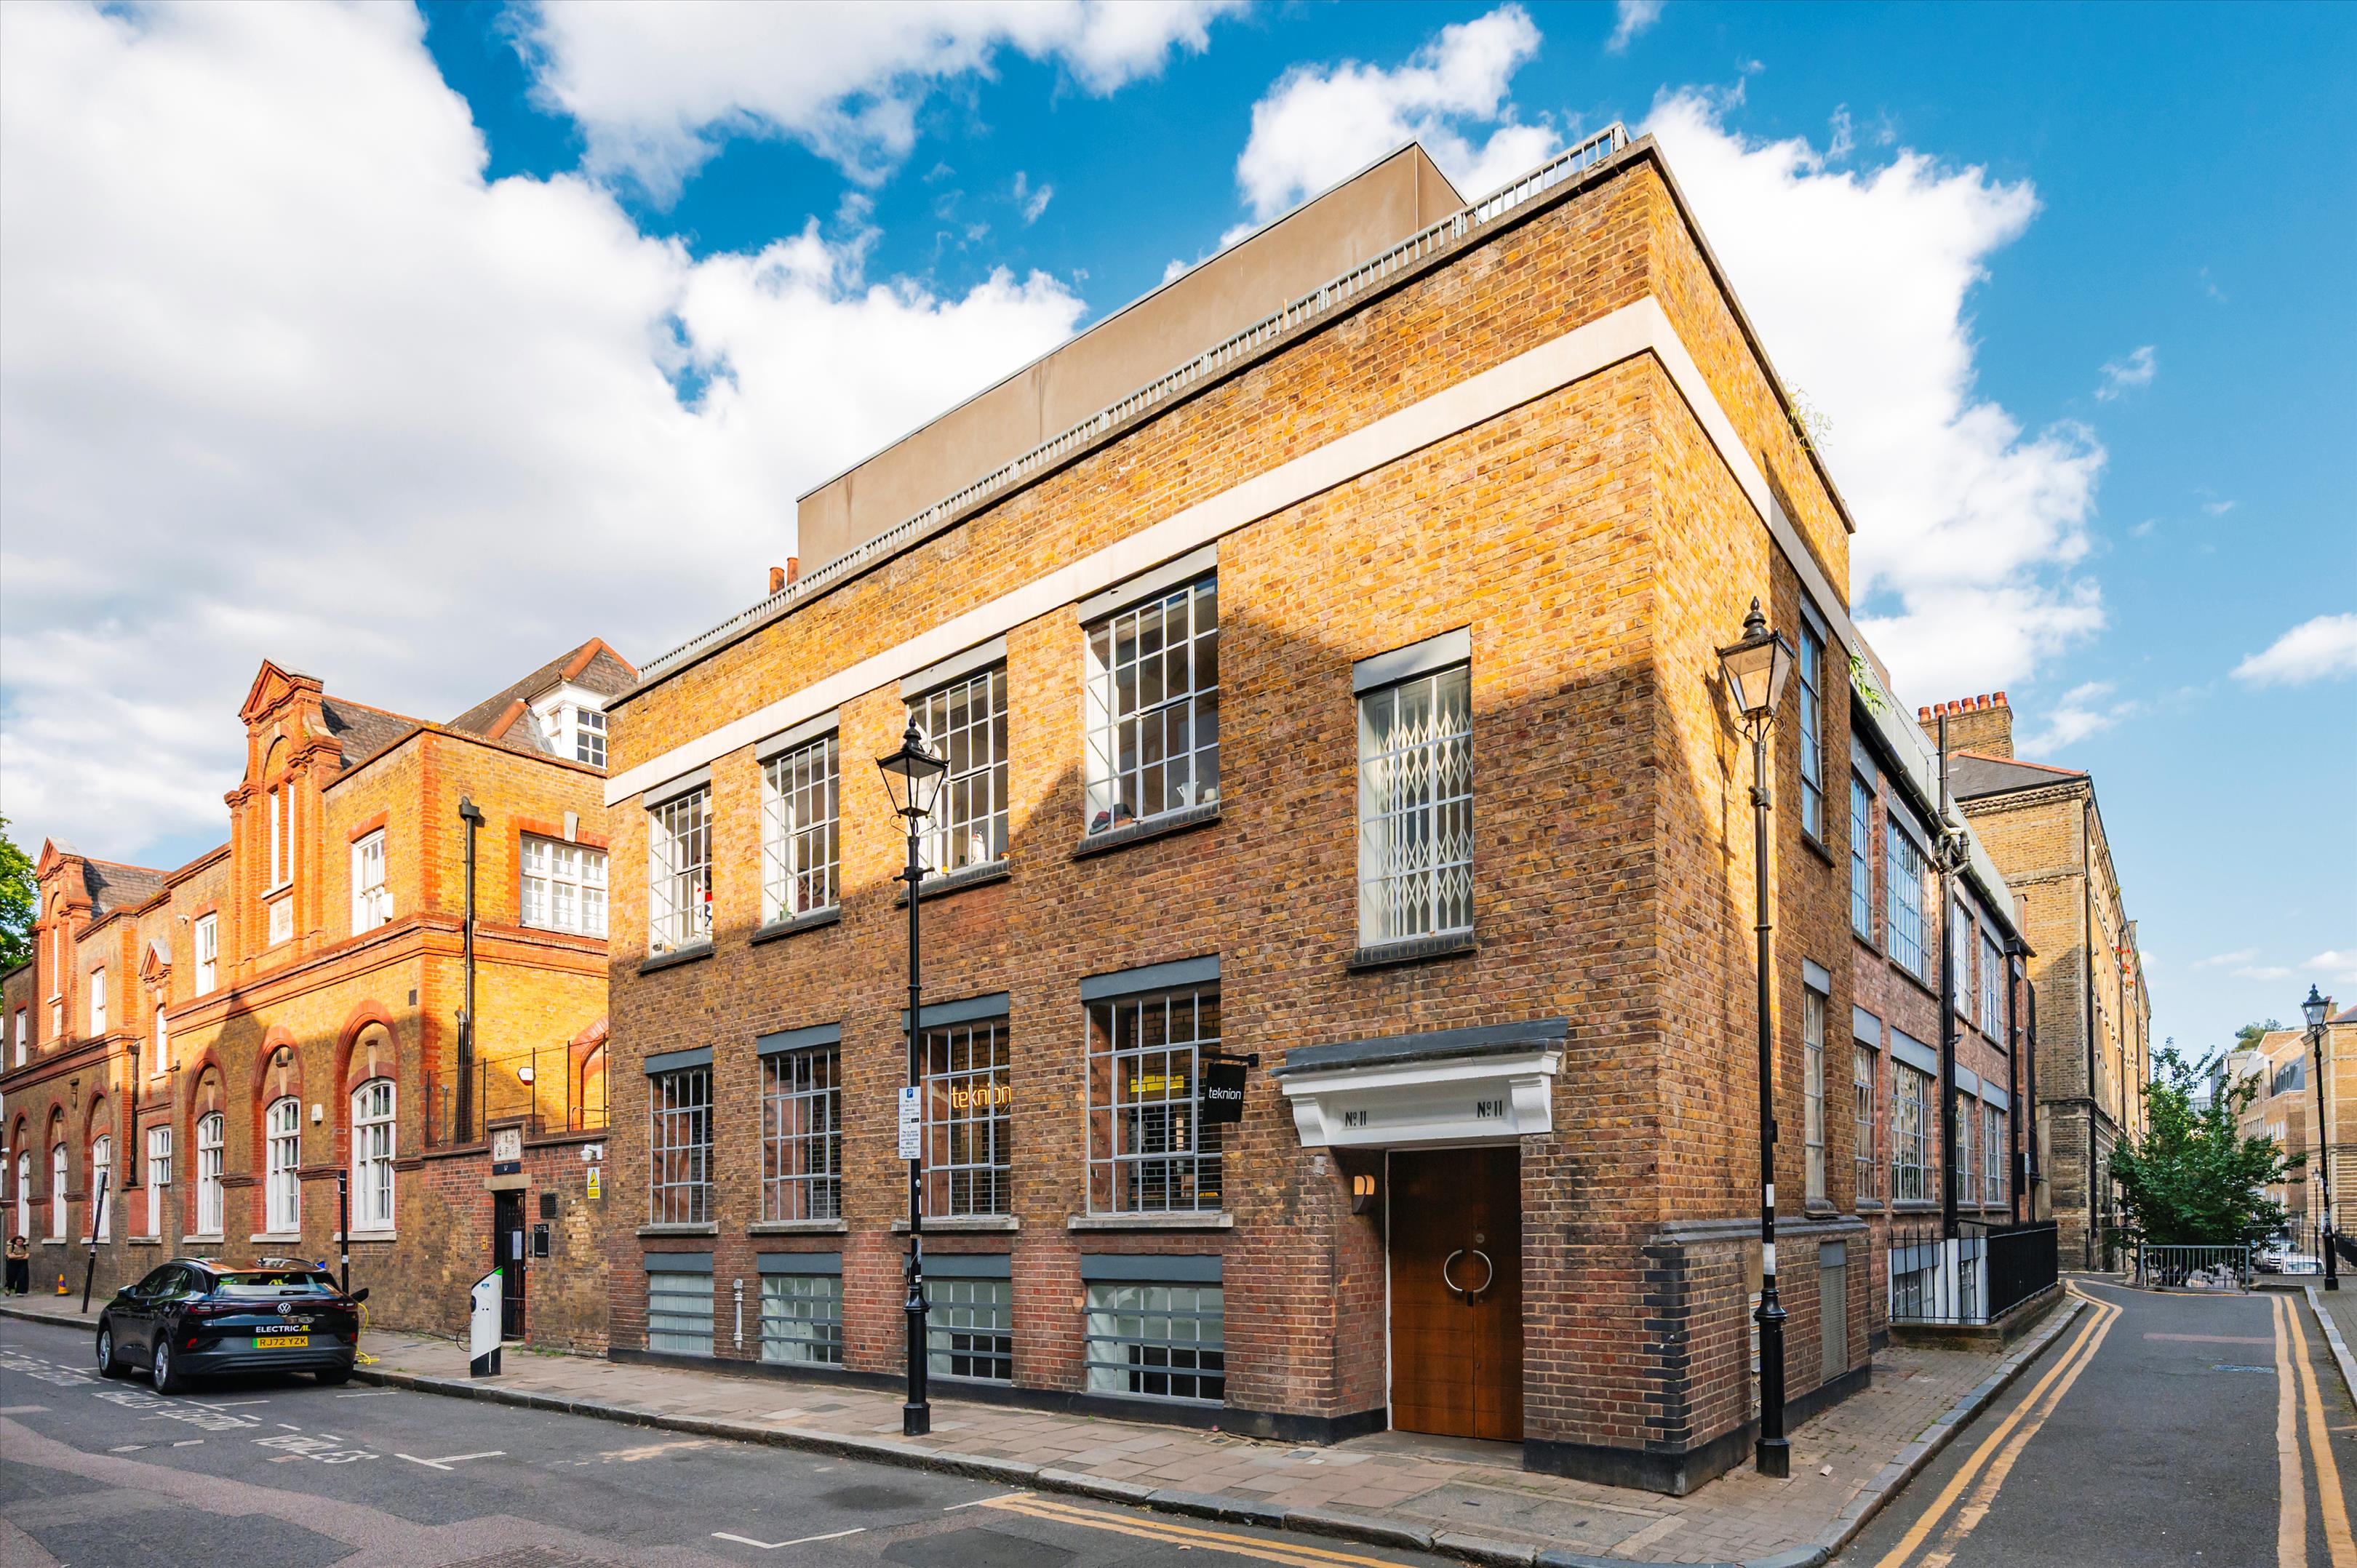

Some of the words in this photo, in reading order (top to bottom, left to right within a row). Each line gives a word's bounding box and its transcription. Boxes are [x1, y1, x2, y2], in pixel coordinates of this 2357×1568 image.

[951, 1082, 1012, 1108] teknion
[1208, 1087, 1241, 1100] teknion
[255, 1324, 311, 1333] ELECTRICAL
[260, 1337, 286, 1346] RJ72
